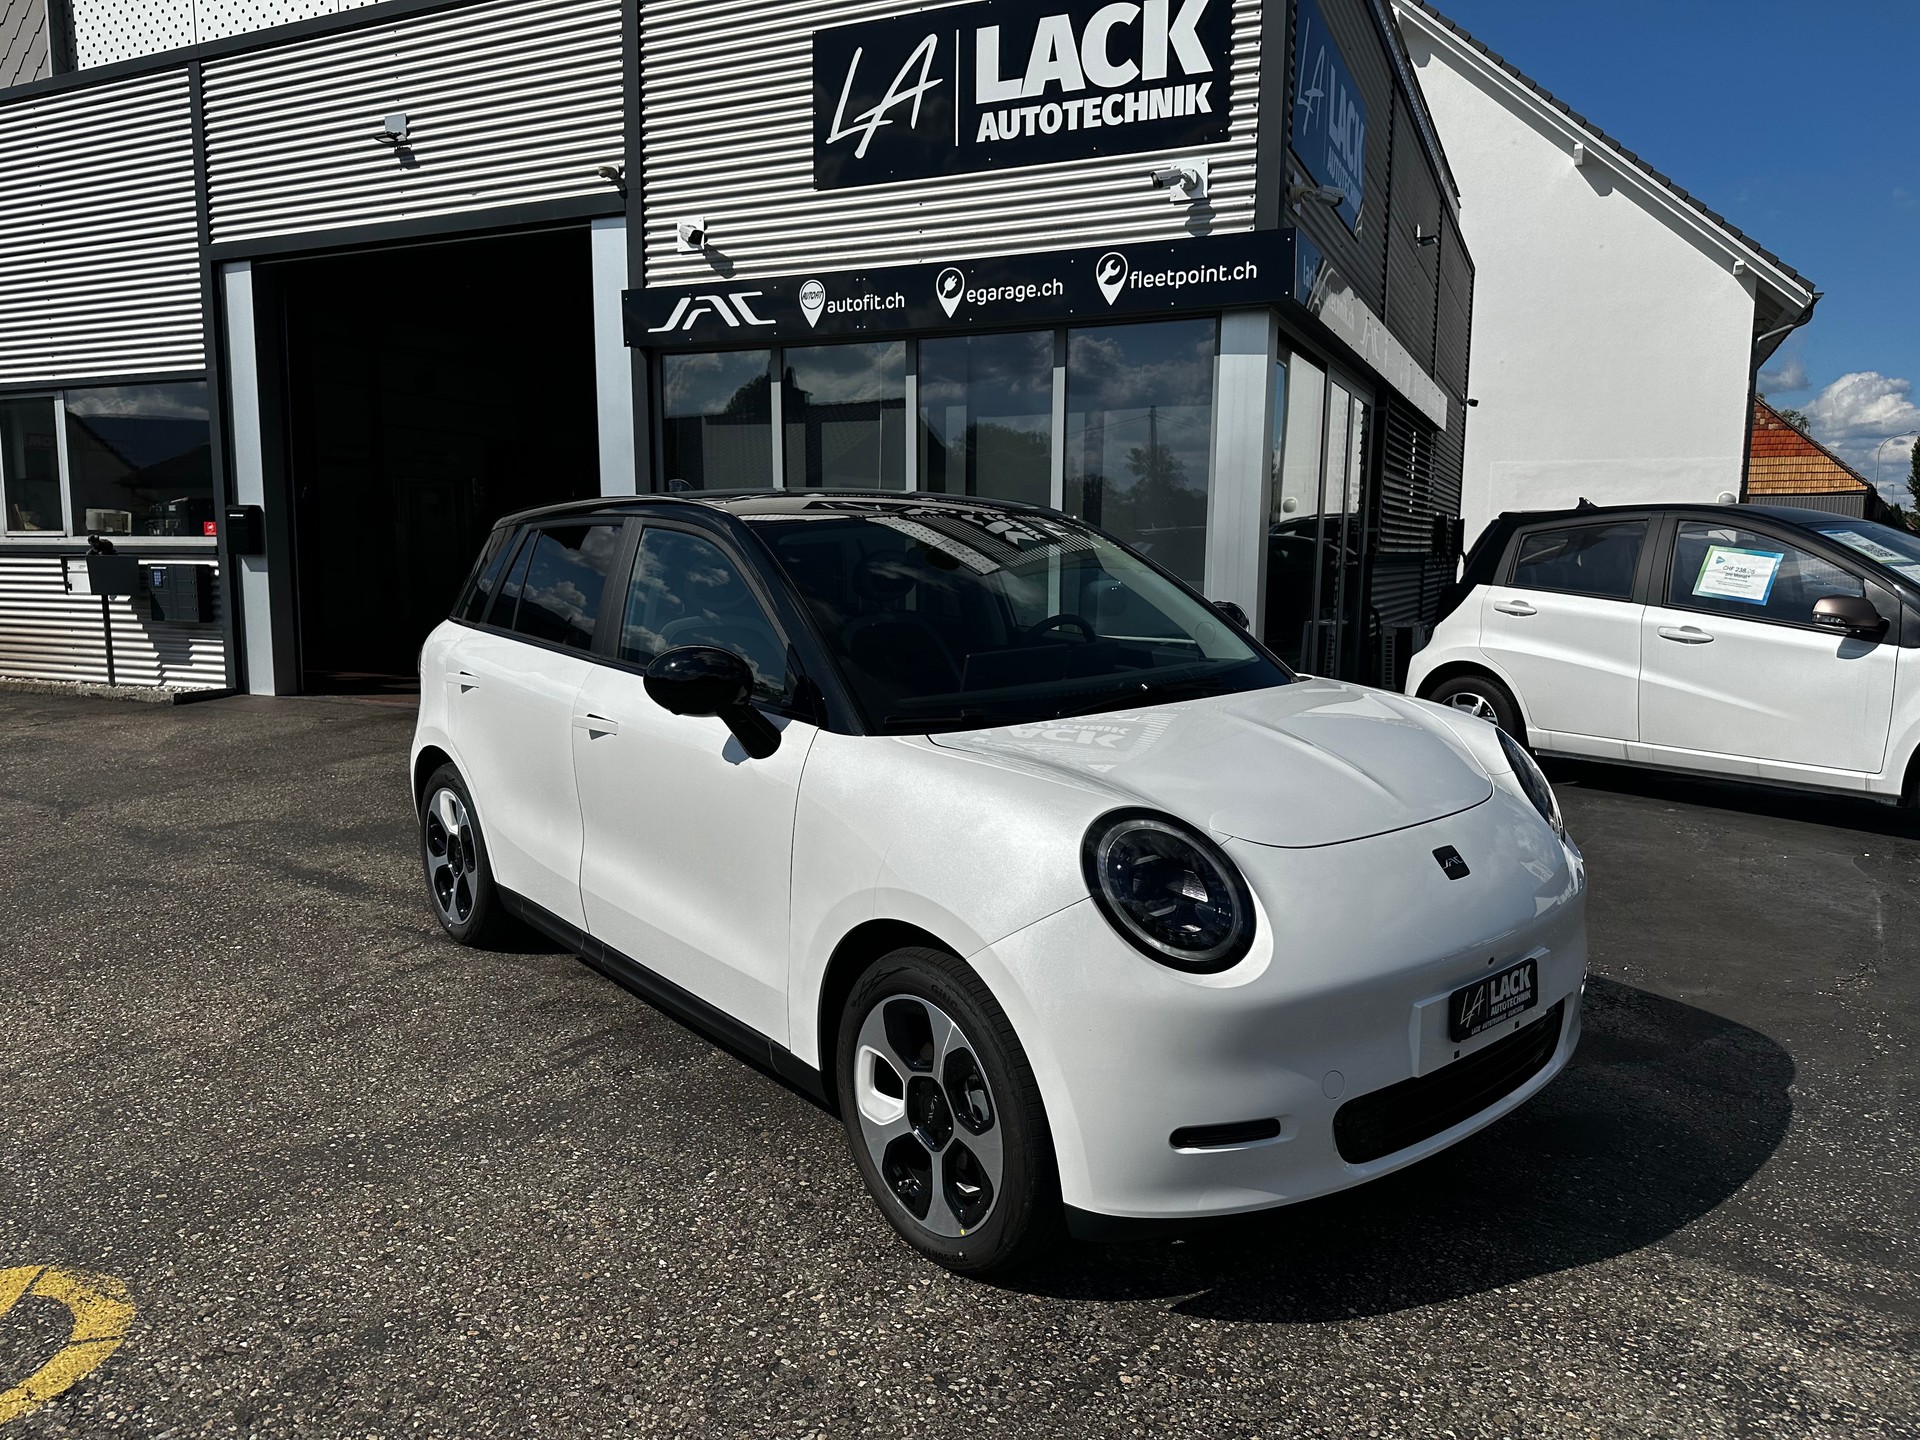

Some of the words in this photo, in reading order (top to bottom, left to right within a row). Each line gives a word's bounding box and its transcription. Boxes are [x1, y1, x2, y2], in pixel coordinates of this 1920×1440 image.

[975, 0, 1214, 105] LACK
[975, 81, 1213, 143] AUTOTECHNIK
[1328, 63, 1365, 187] LACK
[966, 279, 1064, 306] egarage.ch
[1129, 261, 1258, 294] fleetpoint.ch
[826, 290, 906, 315] autofit.ch
[1490, 964, 1532, 1006] LACK
[1490, 988, 1531, 1017] AUTOTECHNIK
